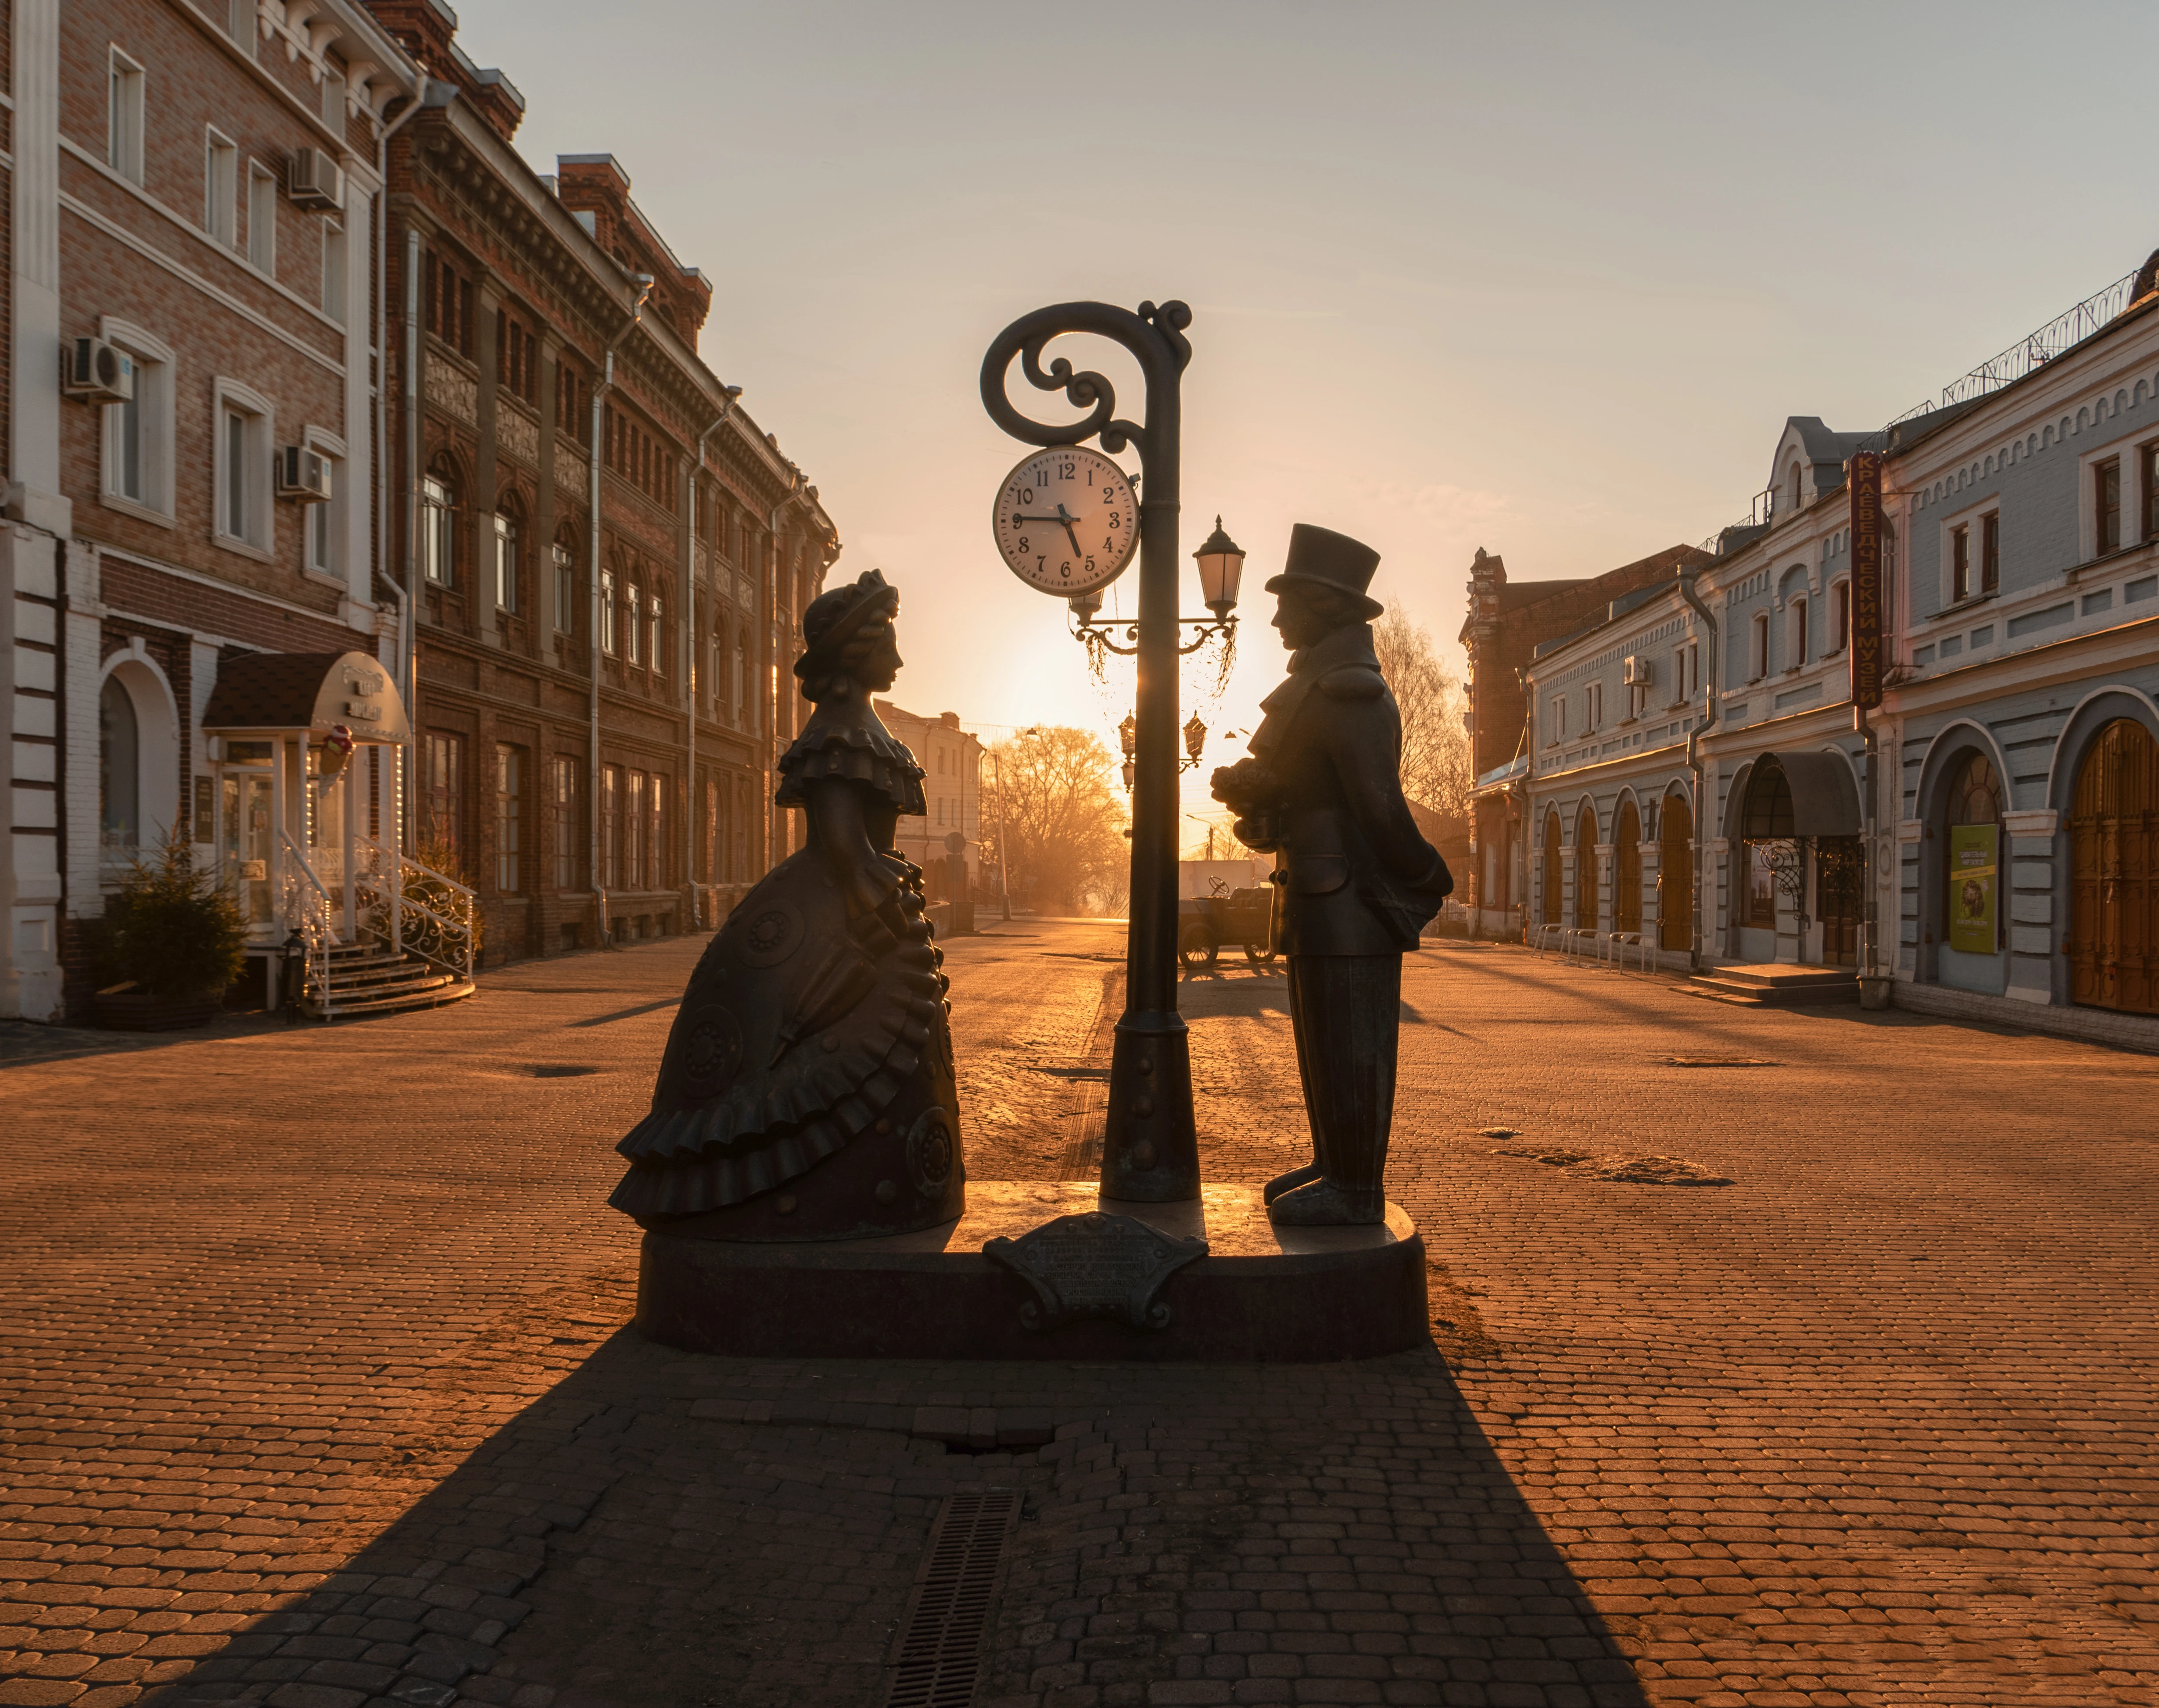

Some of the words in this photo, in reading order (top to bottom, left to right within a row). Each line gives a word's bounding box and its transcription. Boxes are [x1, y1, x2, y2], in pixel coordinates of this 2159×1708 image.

[1036, 470, 1048, 487] 11
[1058, 462, 1075, 480] 12
[1087, 469, 1093, 486] 1
[1016, 488, 1033, 505] 10
[1103, 487, 1114, 504] 2
[1012, 513, 1022, 530] 9
[1109, 512, 1120, 529] 3
[1018, 537, 1029, 553] 8
[1102, 537, 1113, 553] 4
[1857, 457, 1877, 629] КРАЕВЕДЧЕСКИЙ
[1037, 555, 1046, 572] 7
[1060, 561, 1071, 578] 6
[1085, 555, 1095, 571] 5
[1857, 636, 1878, 703] МУЗЕЙ
